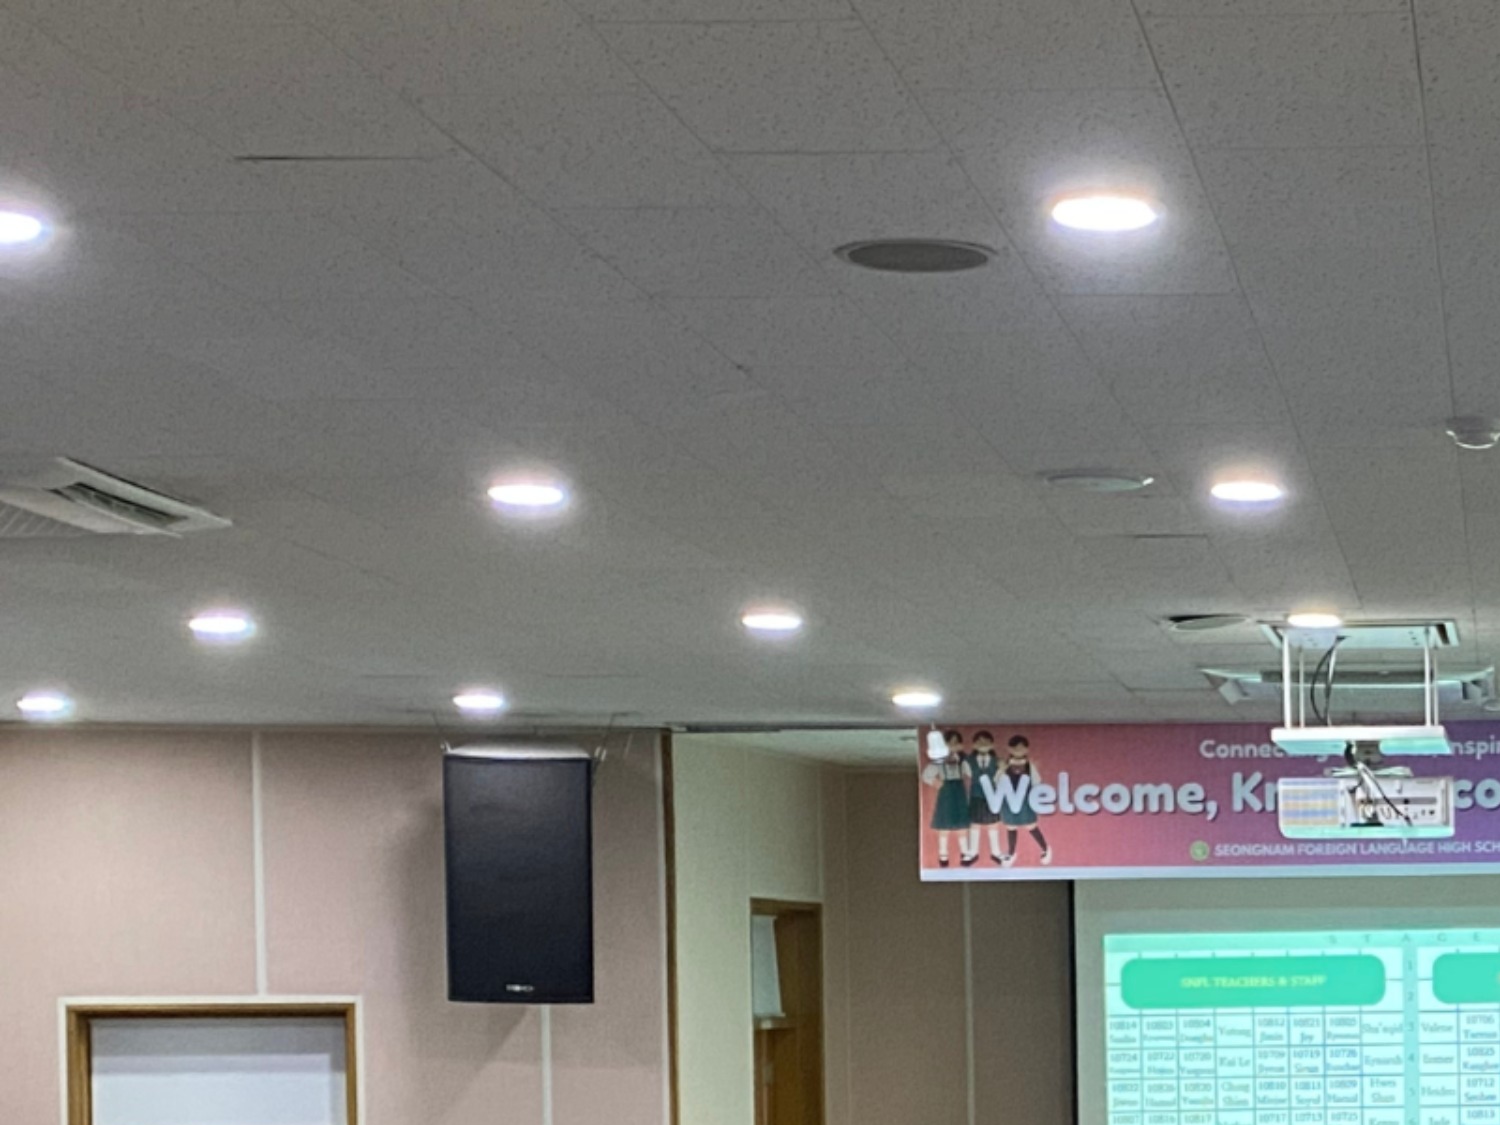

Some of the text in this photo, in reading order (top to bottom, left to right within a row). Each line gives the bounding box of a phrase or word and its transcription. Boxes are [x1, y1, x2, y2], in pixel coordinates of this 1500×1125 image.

[1199, 740, 1329, 763] Connec
[979, 771, 1218, 821] Welcome,
[1214, 843, 1295, 857] SEONGNAM
[1297, 842, 1357, 856] FOREIGN
[1359, 841, 1435, 855] LANGUAGE
[1438, 841, 1471, 854] HIGH
